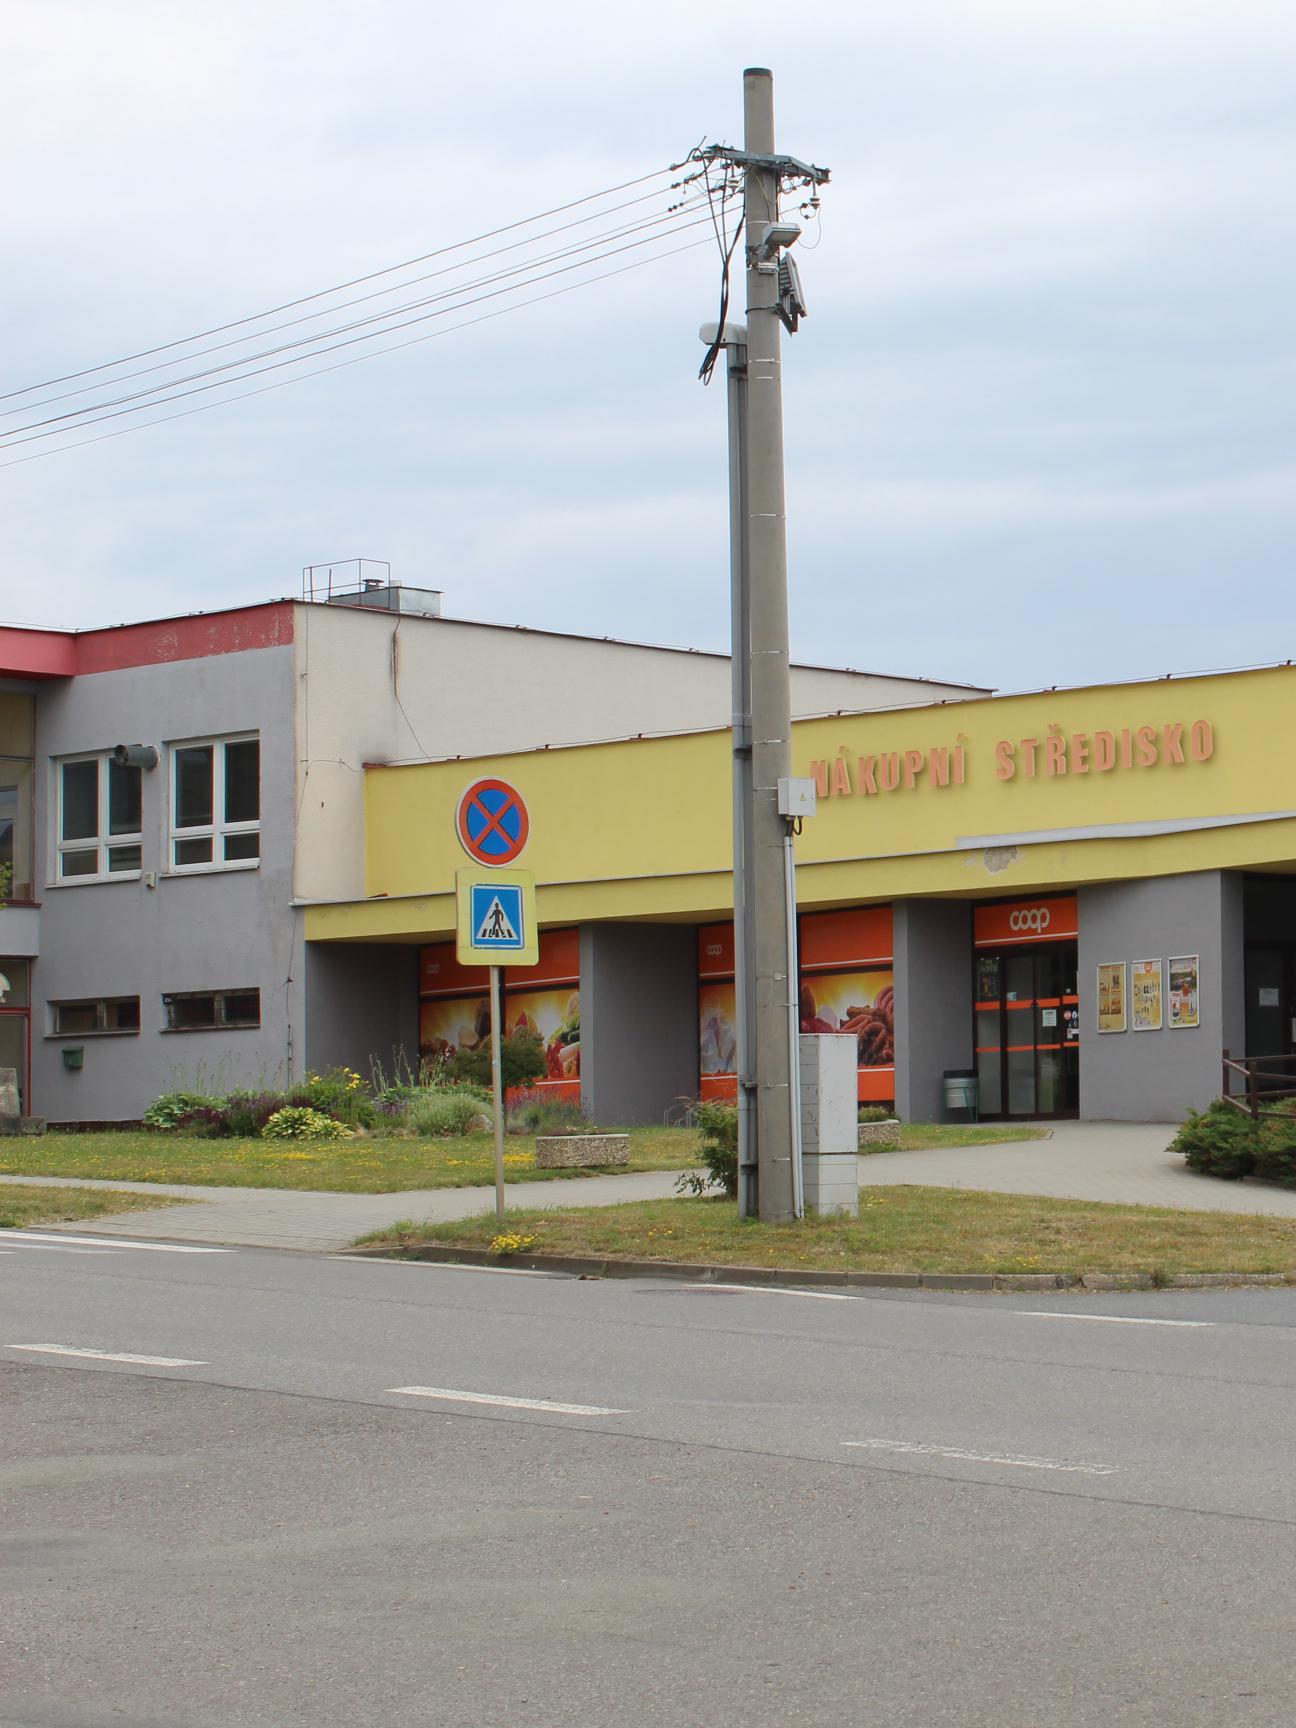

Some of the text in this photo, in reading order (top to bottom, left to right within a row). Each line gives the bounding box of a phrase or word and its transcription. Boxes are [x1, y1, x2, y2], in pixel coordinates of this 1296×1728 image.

[810, 719, 1214, 798] NÁKUPNÍ STŘEDISKO
[1009, 907, 1050, 933] coop
